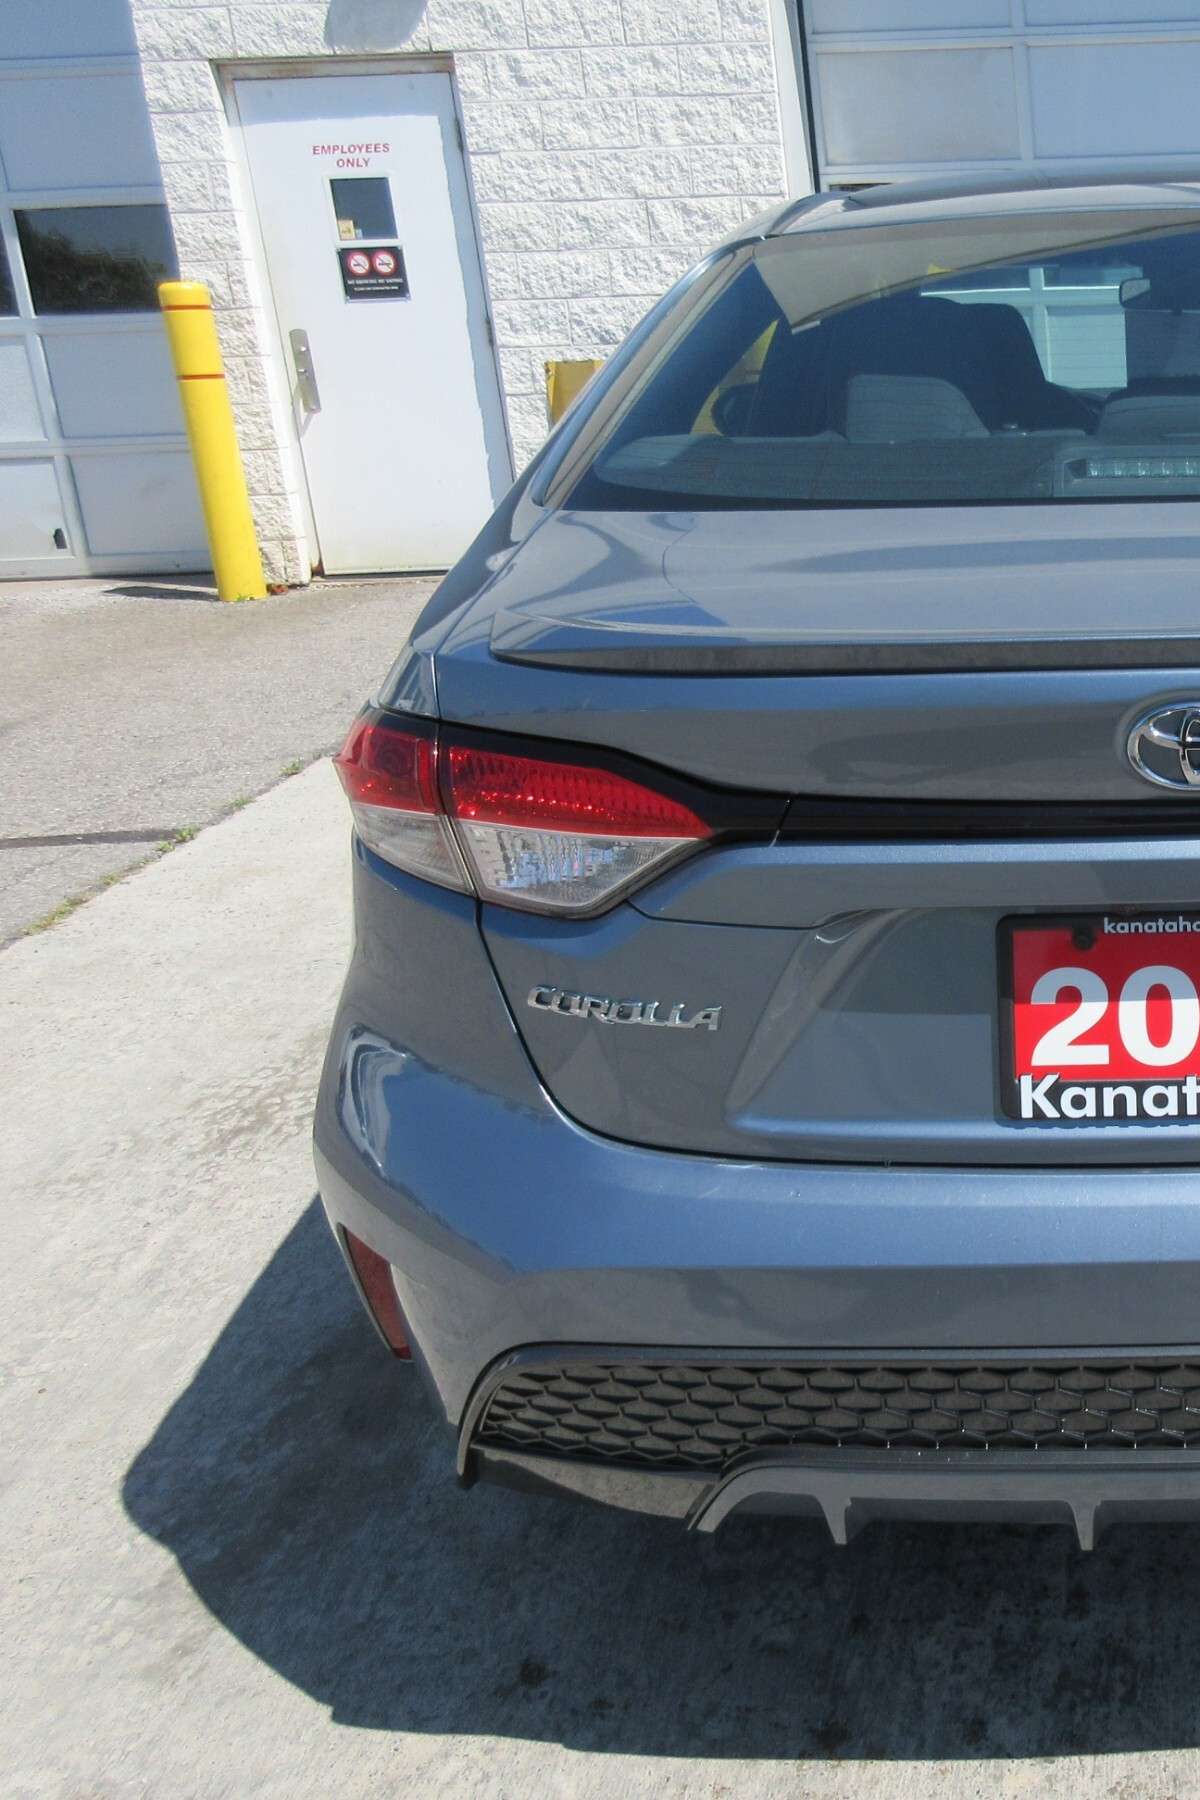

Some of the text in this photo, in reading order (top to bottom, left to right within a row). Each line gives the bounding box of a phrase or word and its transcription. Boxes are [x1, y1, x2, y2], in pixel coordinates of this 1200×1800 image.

[312, 142, 390, 155] EMPLOYEES
[336, 158, 370, 168] ONLY
[527, 985, 722, 1031] COROLLA
